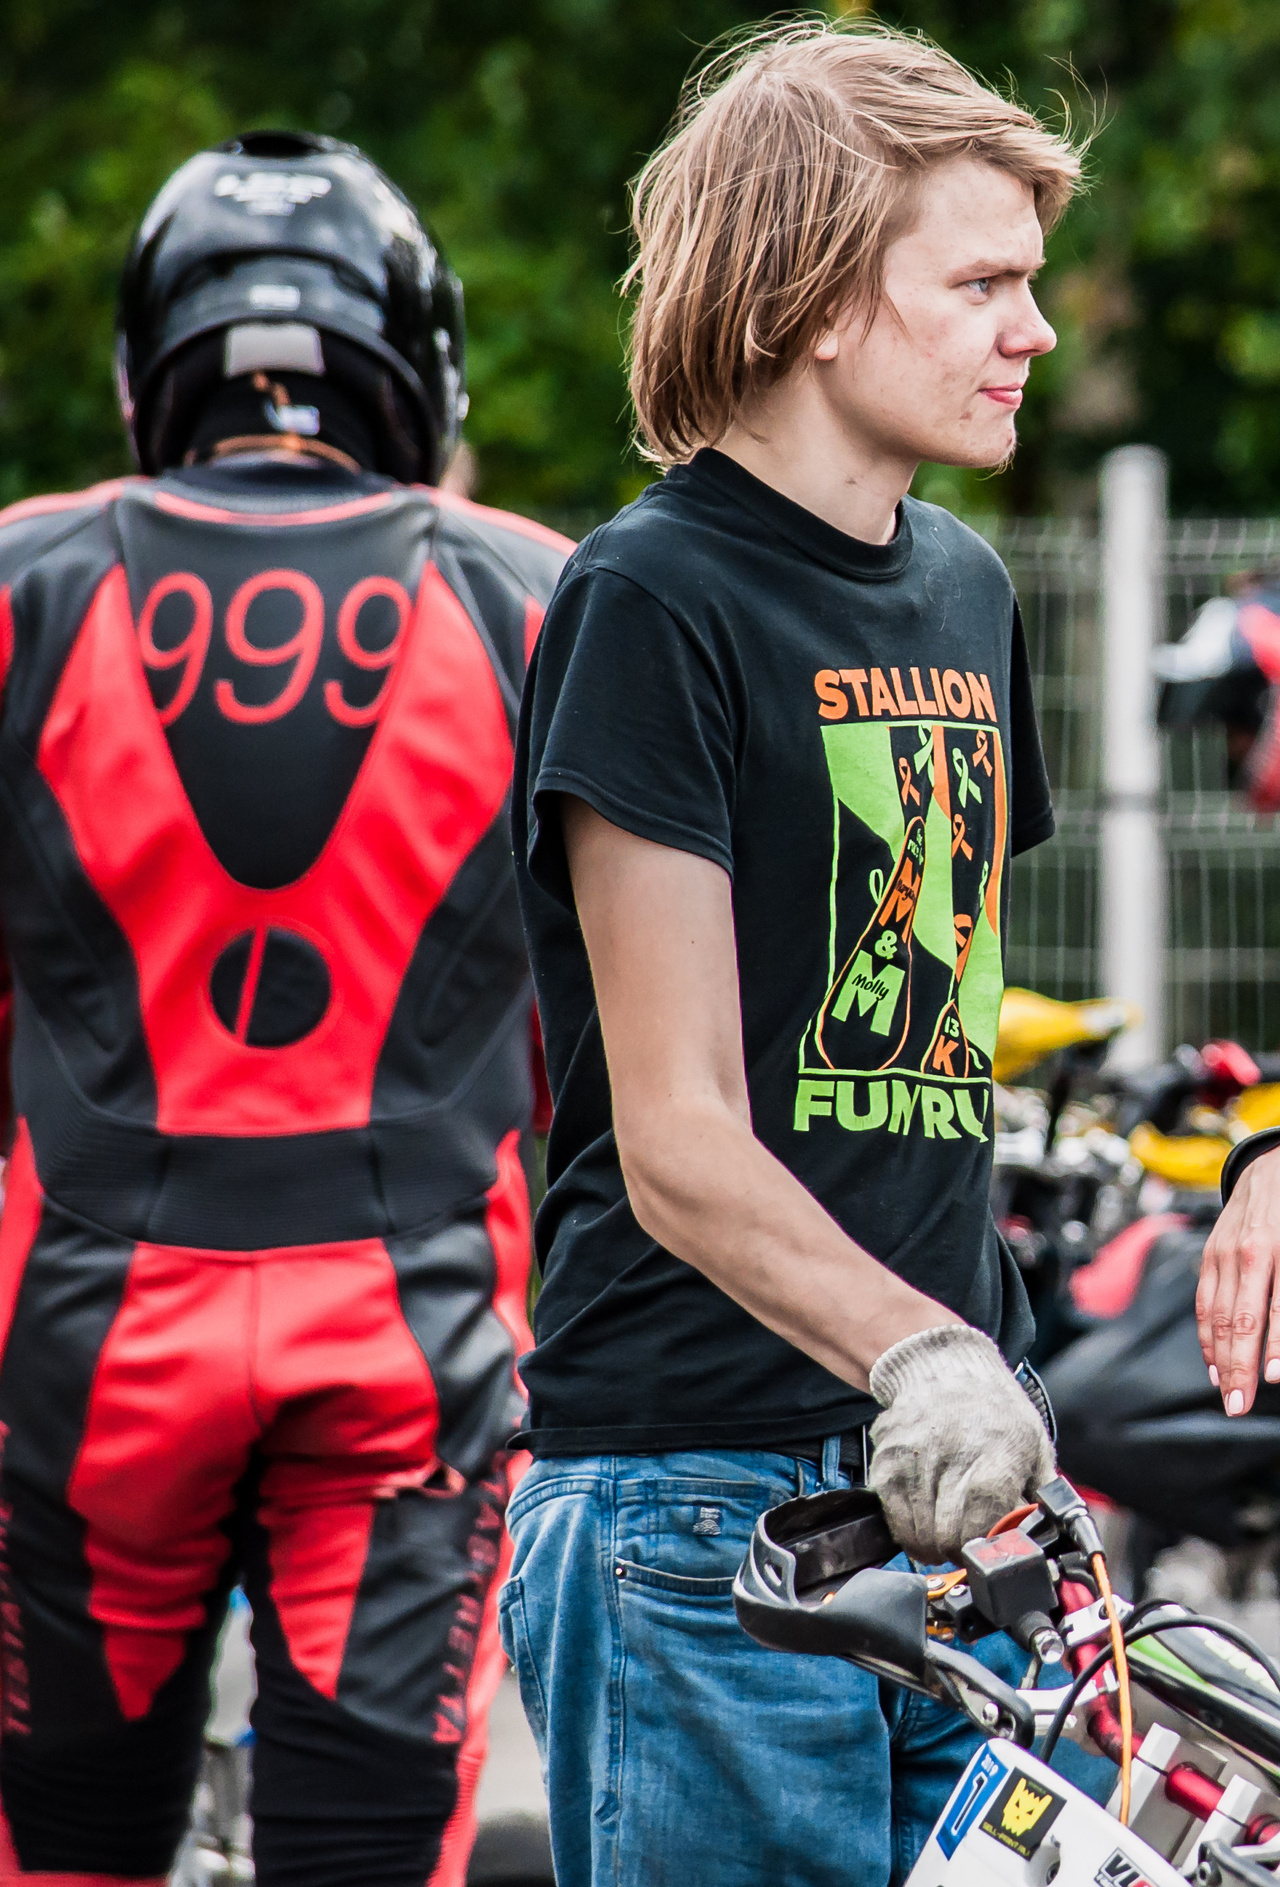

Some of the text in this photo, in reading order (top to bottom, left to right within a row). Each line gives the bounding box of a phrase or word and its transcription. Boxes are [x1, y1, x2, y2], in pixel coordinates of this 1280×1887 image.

[137, 567, 414, 728] 999
[814, 667, 998, 723] STALLION
[852, 973, 890, 1001] Molly
[944, 1016, 960, 1038] 13
[932, 1034, 959, 1077] K
